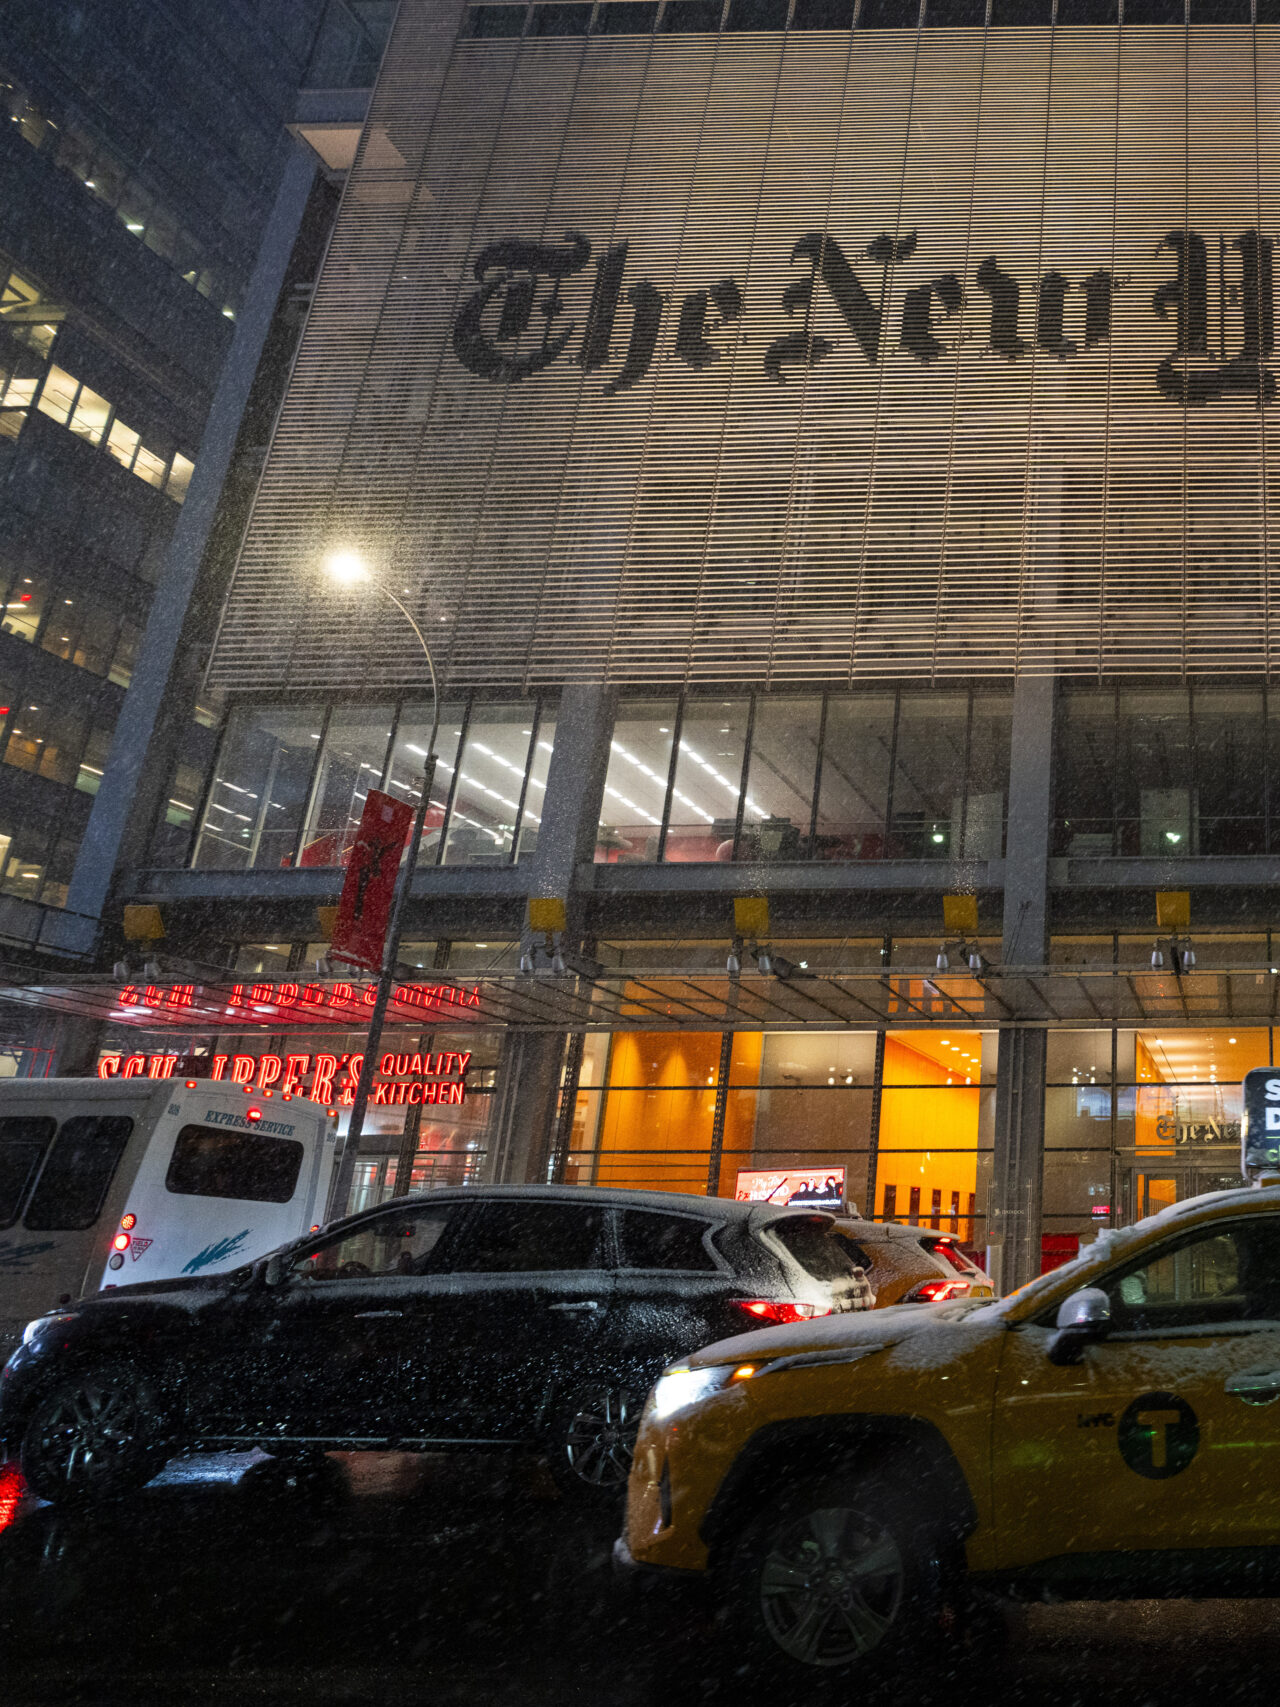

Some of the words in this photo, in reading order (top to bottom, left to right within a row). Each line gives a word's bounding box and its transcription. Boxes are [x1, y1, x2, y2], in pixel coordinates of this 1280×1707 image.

[452, 230, 744, 397] The
[764, 229, 1133, 385] New
[380, 1051, 471, 1077] QUALITY
[374, 1081, 465, 1105] KITCHEN
[203, 1109, 252, 1130] EXPRESS
[253, 1119, 296, 1137] SERVICE
[1156, 1114, 1201, 1144] The
